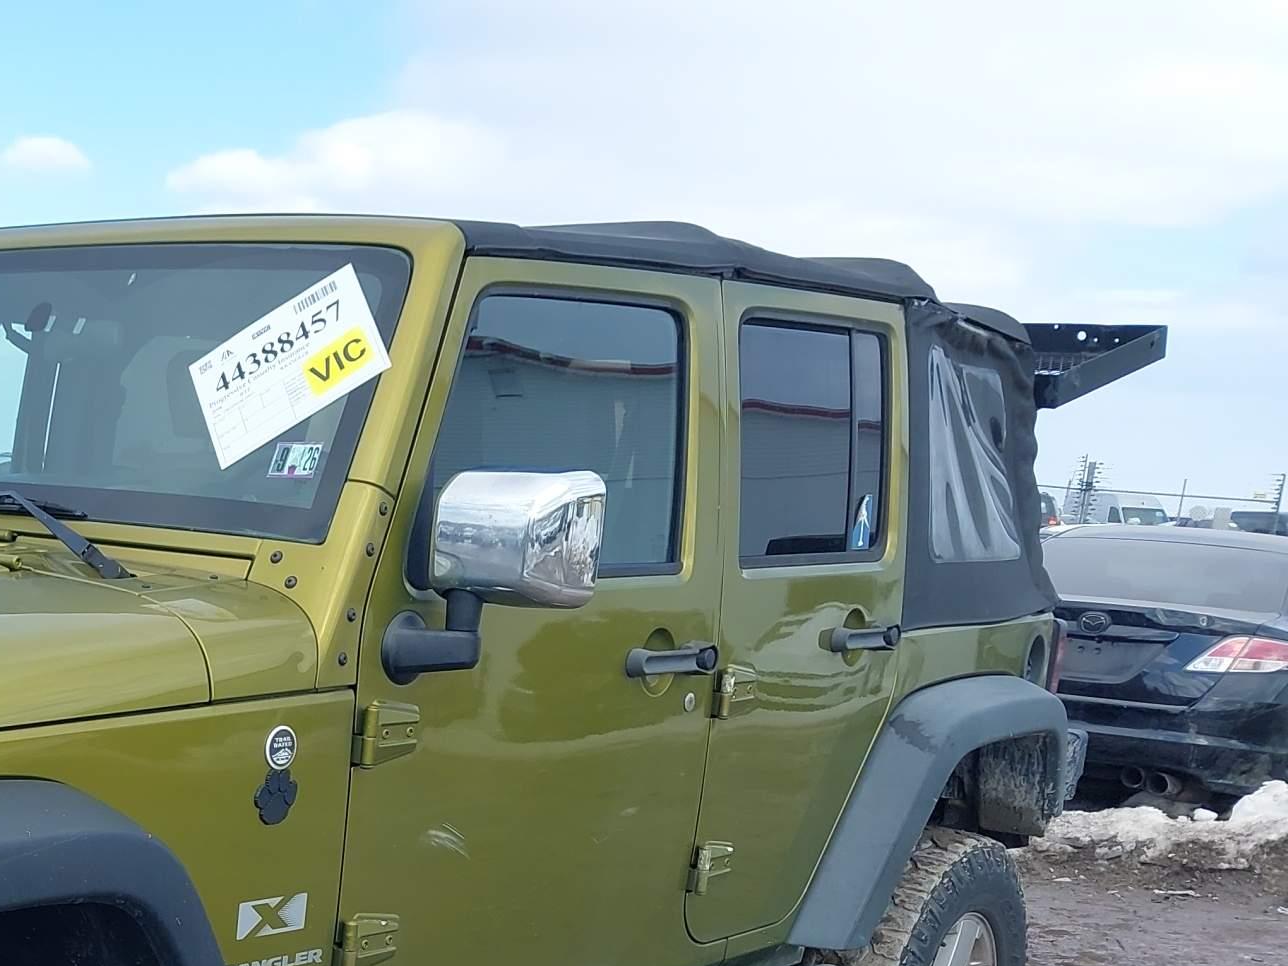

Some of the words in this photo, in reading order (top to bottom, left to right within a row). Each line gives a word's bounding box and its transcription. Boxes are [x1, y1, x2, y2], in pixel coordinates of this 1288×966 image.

[215, 299, 341, 393] 44388457
[308, 338, 367, 383] VIC
[302, 447, 320, 471] 26
